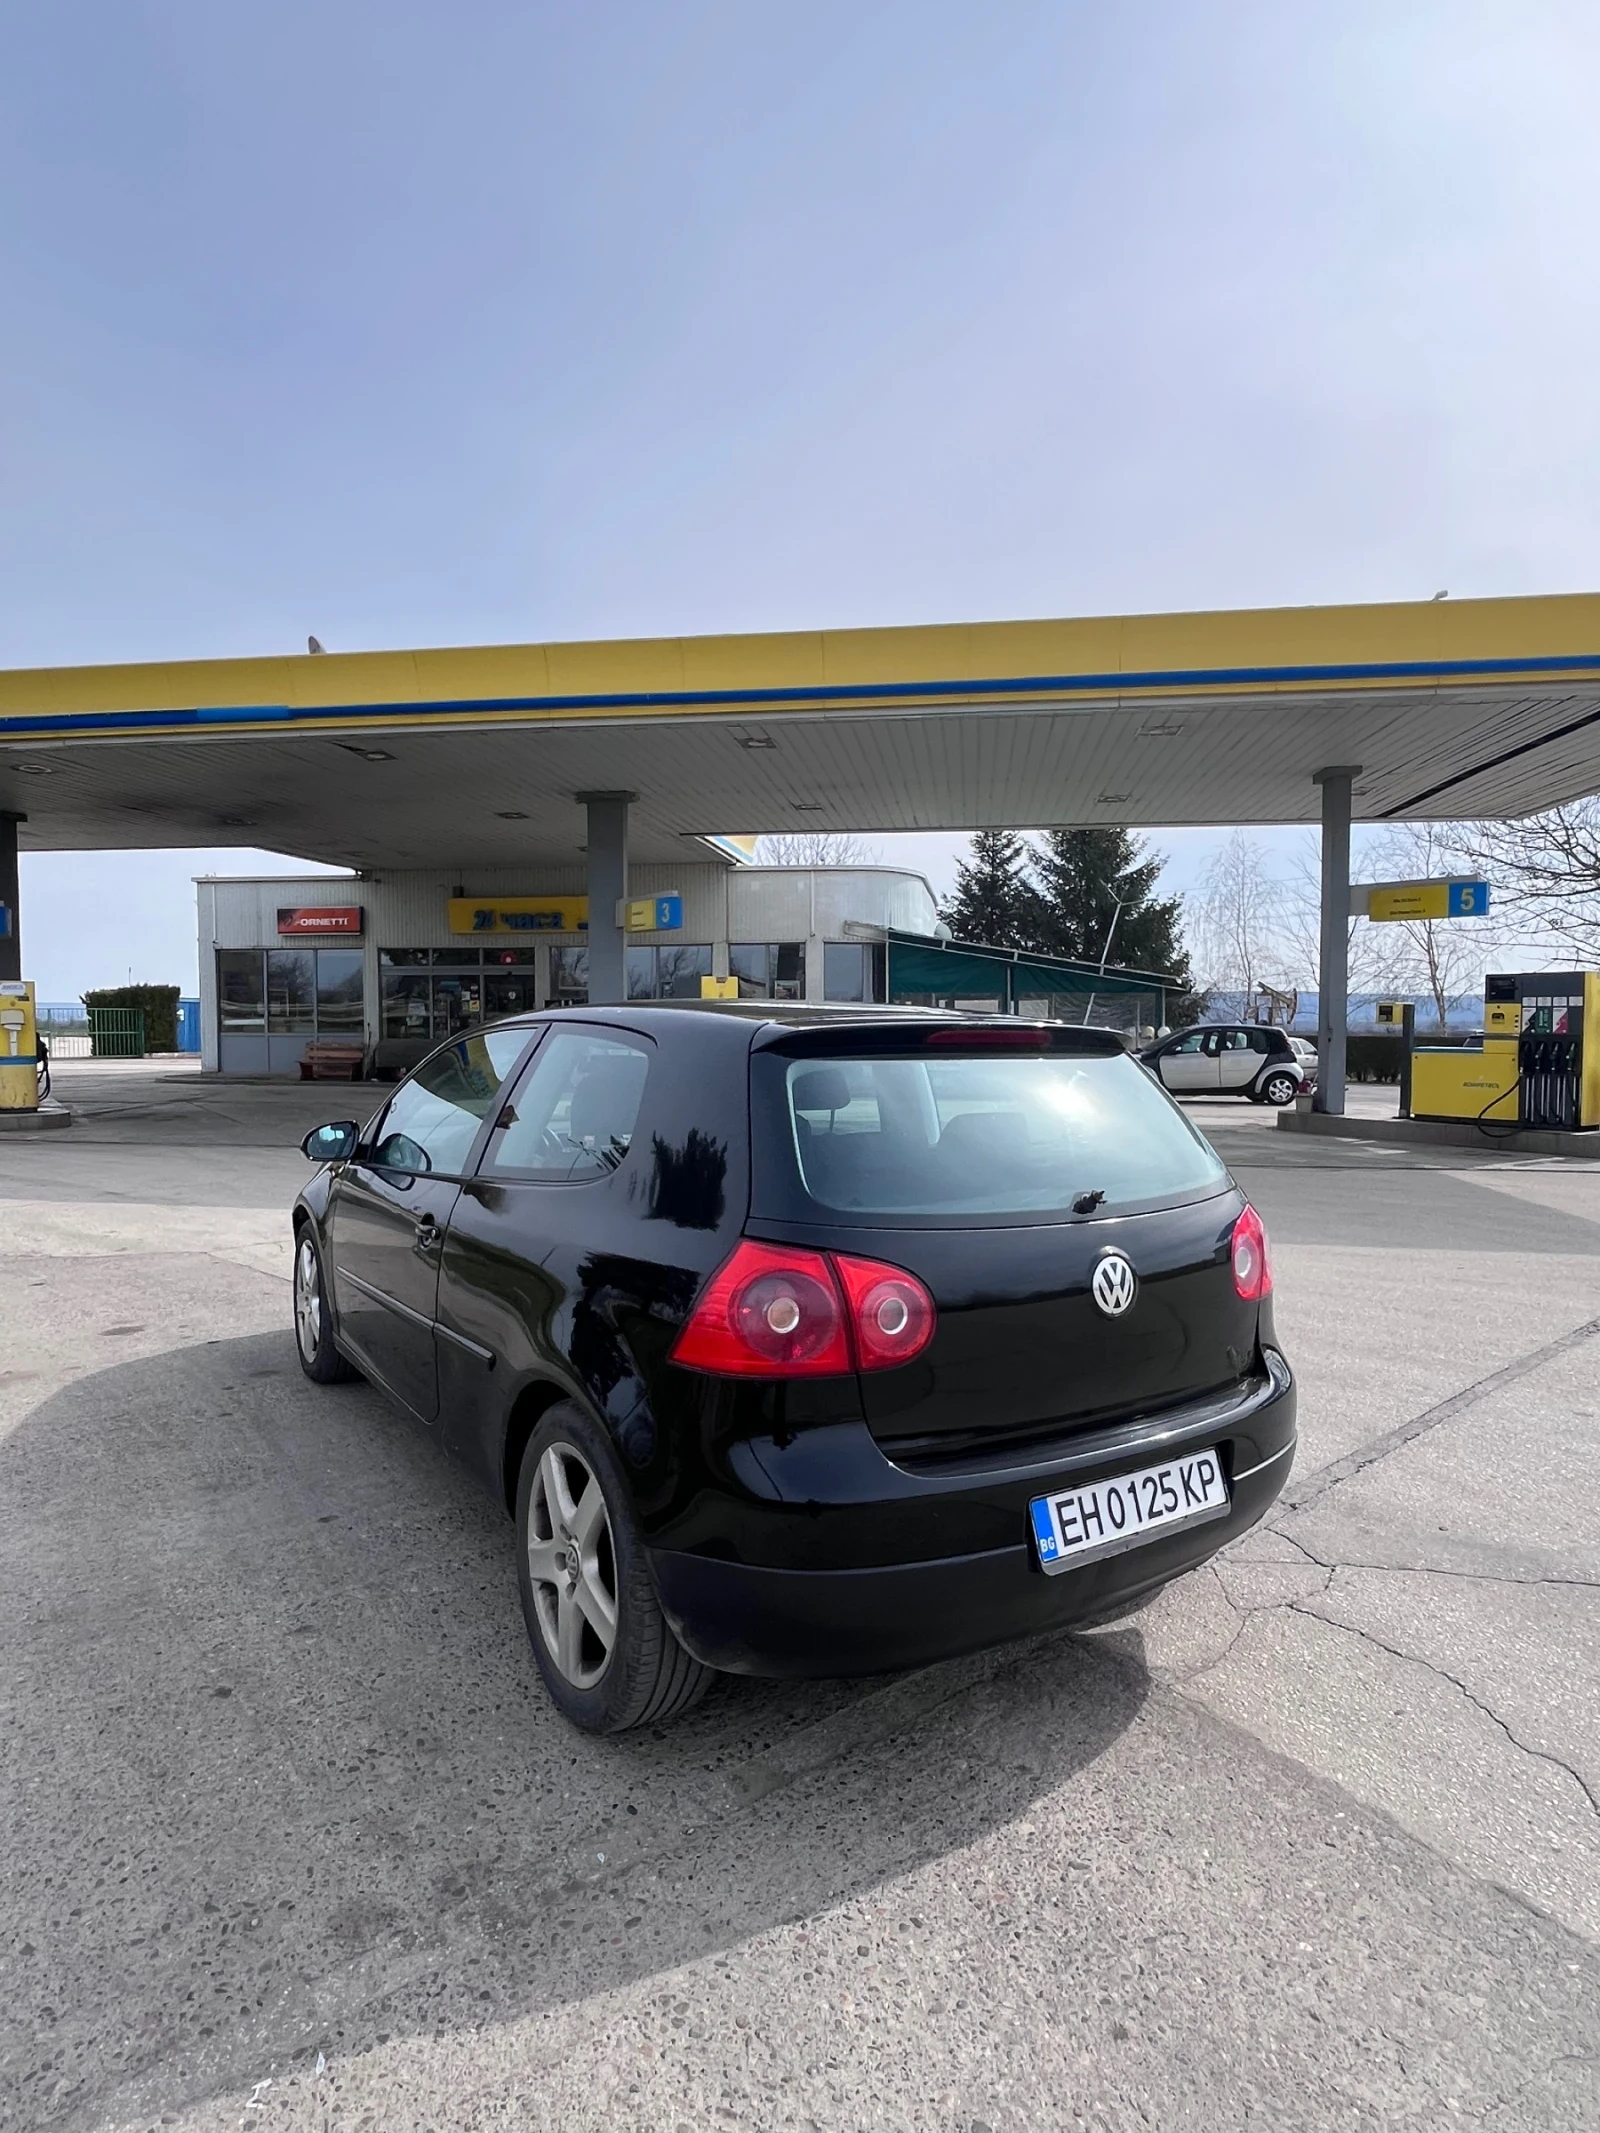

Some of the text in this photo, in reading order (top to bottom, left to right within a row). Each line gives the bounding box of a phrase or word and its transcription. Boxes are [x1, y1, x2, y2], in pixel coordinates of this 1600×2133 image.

[1460, 887, 1475, 911] 5
[661, 902, 670, 923] 3
[1093, 1256, 1134, 1314] VW
[1040, 1536, 1055, 1552] BG
